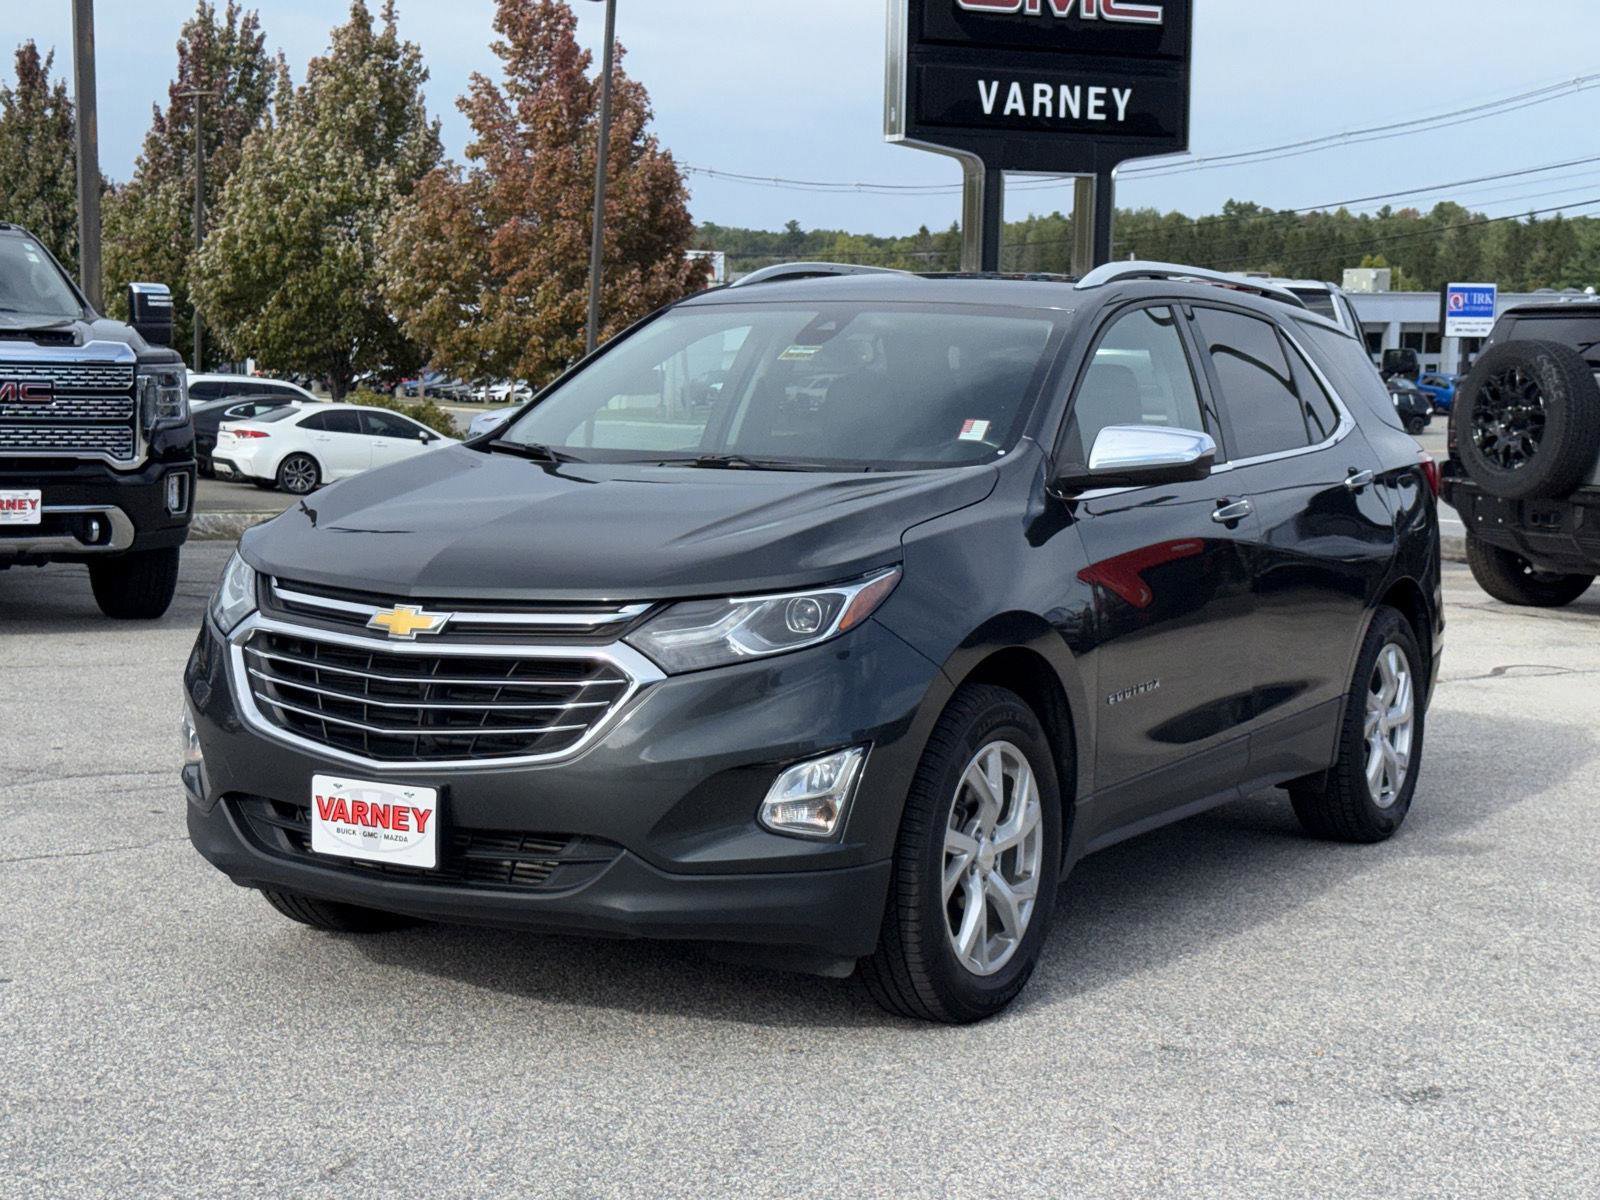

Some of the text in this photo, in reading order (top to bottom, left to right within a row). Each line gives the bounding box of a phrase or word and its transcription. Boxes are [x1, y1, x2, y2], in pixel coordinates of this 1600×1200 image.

[977, 79, 1133, 121] VARNEY
[315, 795, 433, 834] VARNEY
[336, 827, 409, 843] BUICK GMC MAZDA
